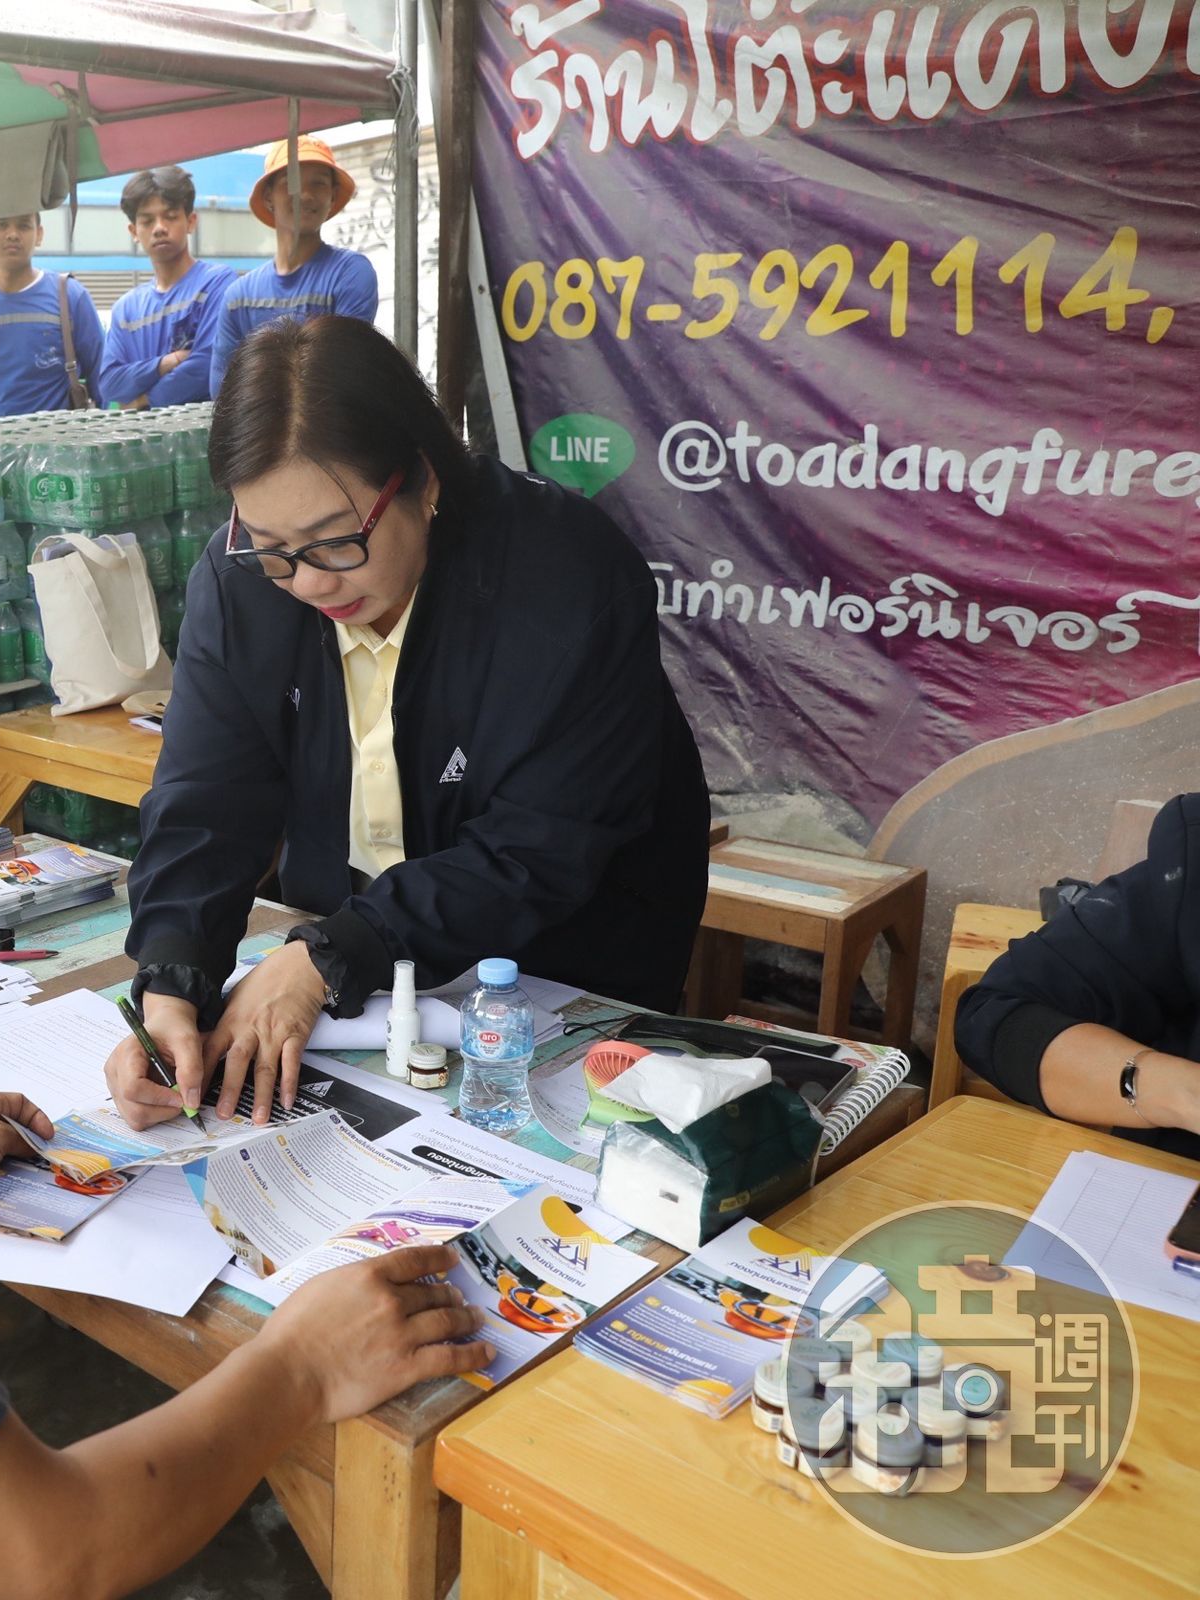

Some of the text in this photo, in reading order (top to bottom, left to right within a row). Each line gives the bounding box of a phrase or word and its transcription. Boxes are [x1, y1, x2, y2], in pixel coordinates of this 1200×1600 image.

[502, 226, 1175, 344] 087-5921114,
[550, 436, 611, 463] LINE
[658, 419, 1200, 516] @toadangfure
[646, 558, 1200, 655] บทำเฟอร์นิเจอร์
[482, 1033, 498, 1042] aro
